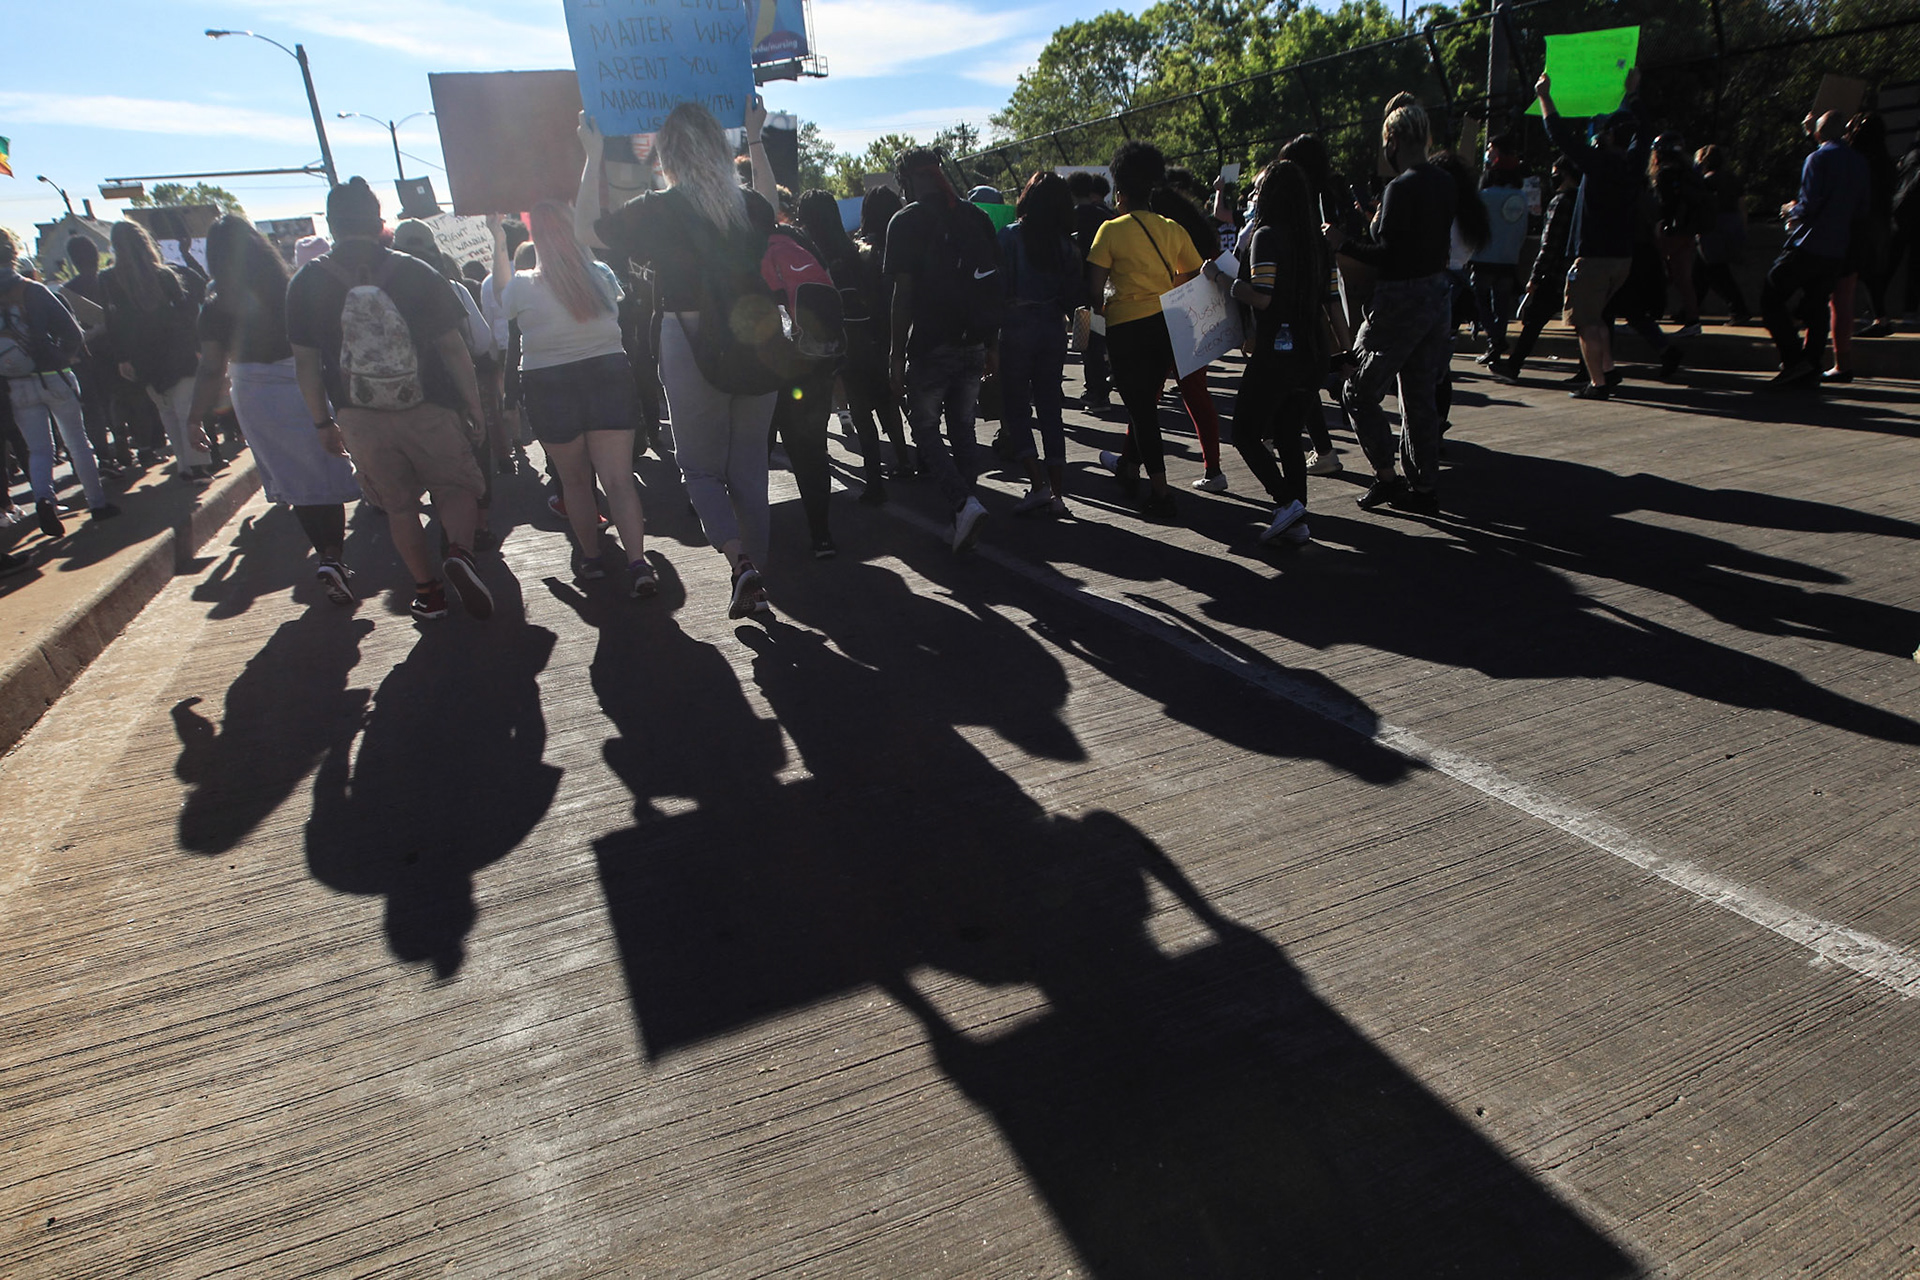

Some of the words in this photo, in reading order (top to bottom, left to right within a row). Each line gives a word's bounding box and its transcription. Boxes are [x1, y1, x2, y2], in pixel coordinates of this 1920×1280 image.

[588, 15, 674, 49] MATTER
[693, 17, 746, 45] WHY
[599, 56, 669, 81] ARENT
[680, 56, 719, 76] YOU
